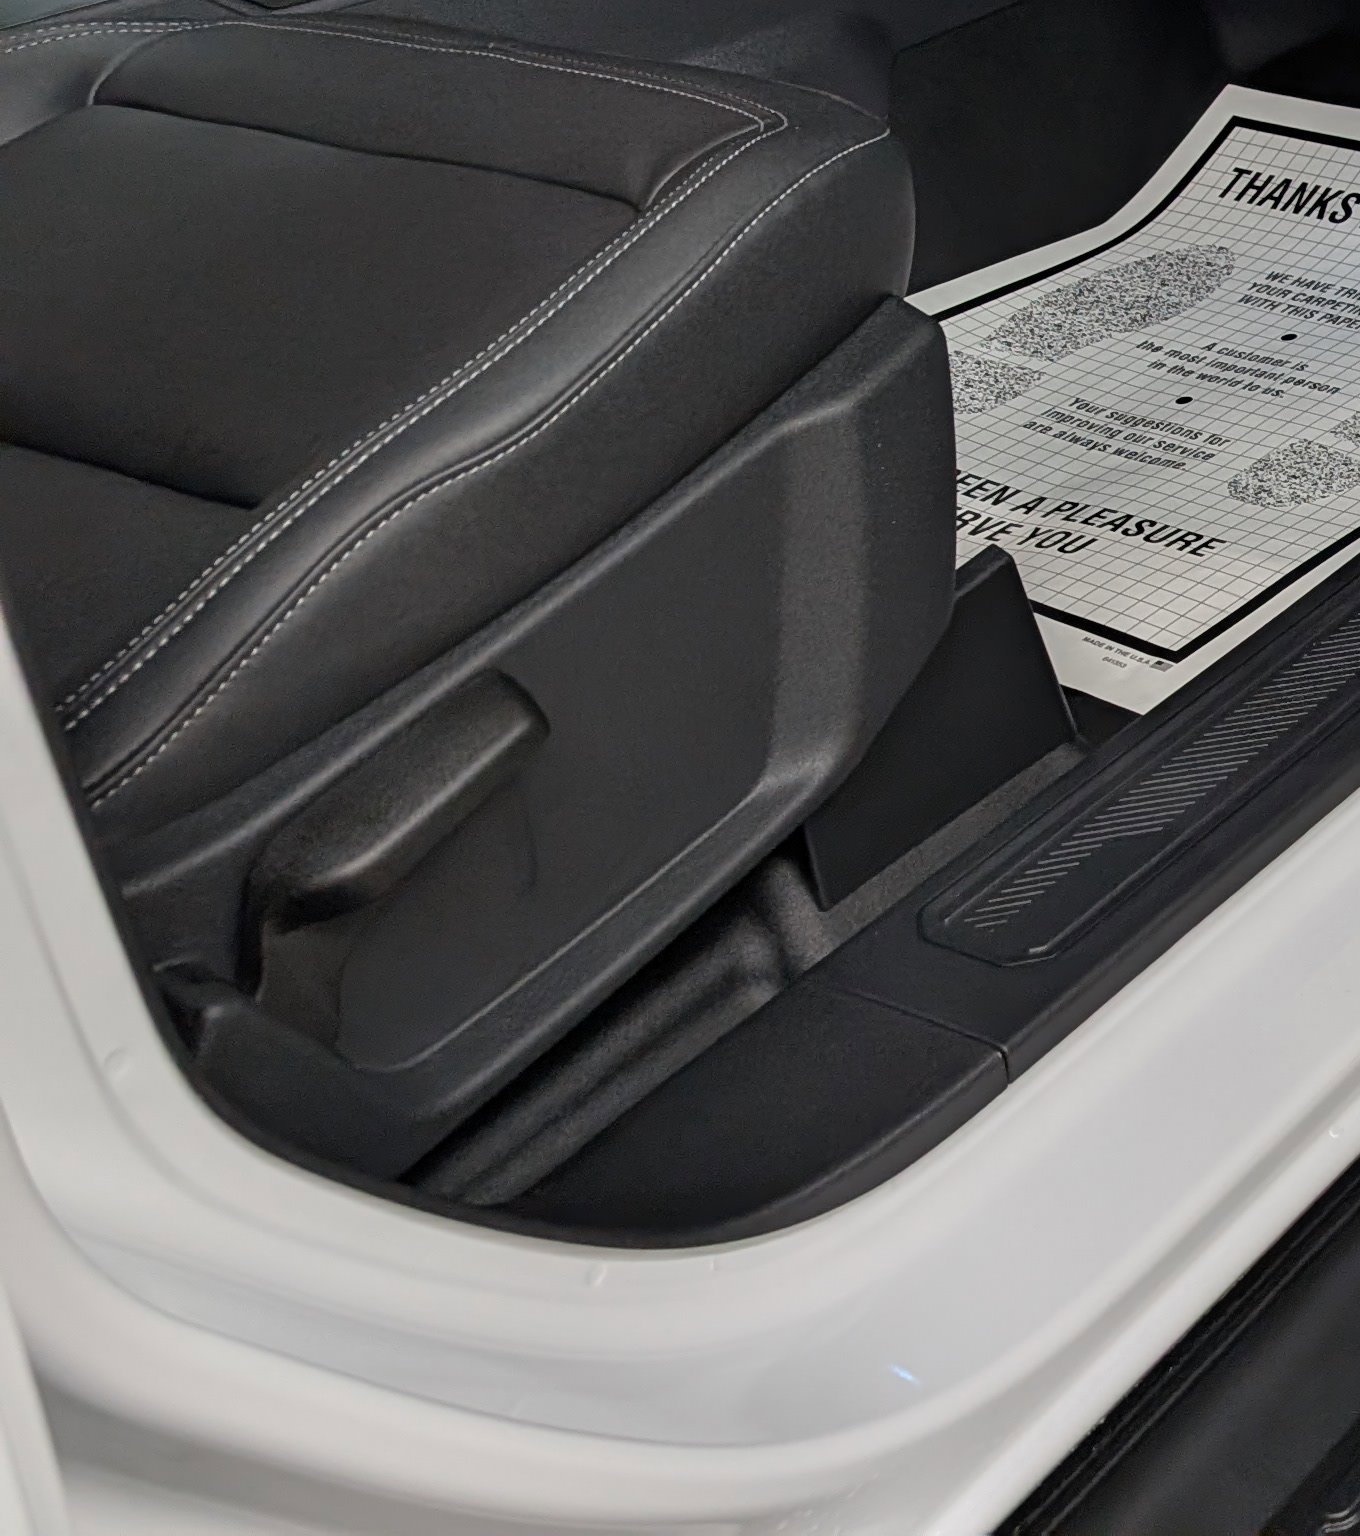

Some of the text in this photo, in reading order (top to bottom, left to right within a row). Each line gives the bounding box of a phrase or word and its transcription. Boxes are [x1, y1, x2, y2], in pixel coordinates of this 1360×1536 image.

[1247, 282, 1293, 299] YOUR
[1265, 271, 1294, 284] WE
[1290, 276, 1336, 294] HAVE
[1237, 294, 1283, 312] WITH
[1281, 304, 1319, 319] THIS
[1135, 340, 1342, 395] the most important person
[1200, 342, 1309, 372] A customer is
[1147, 359, 1285, 398] in the world to us.
[1041, 407, 1217, 461] improving our service
[1068, 397, 1232, 448] Your suggestions for
[1023, 420, 1188, 471] are always welcome.
[957, 469, 1227, 557] EEN A PLEASURE
[957, 510, 1098, 554] RVE YOU
[1082, 636, 1106, 648] MADE
[1114, 648, 1130, 657] THE
